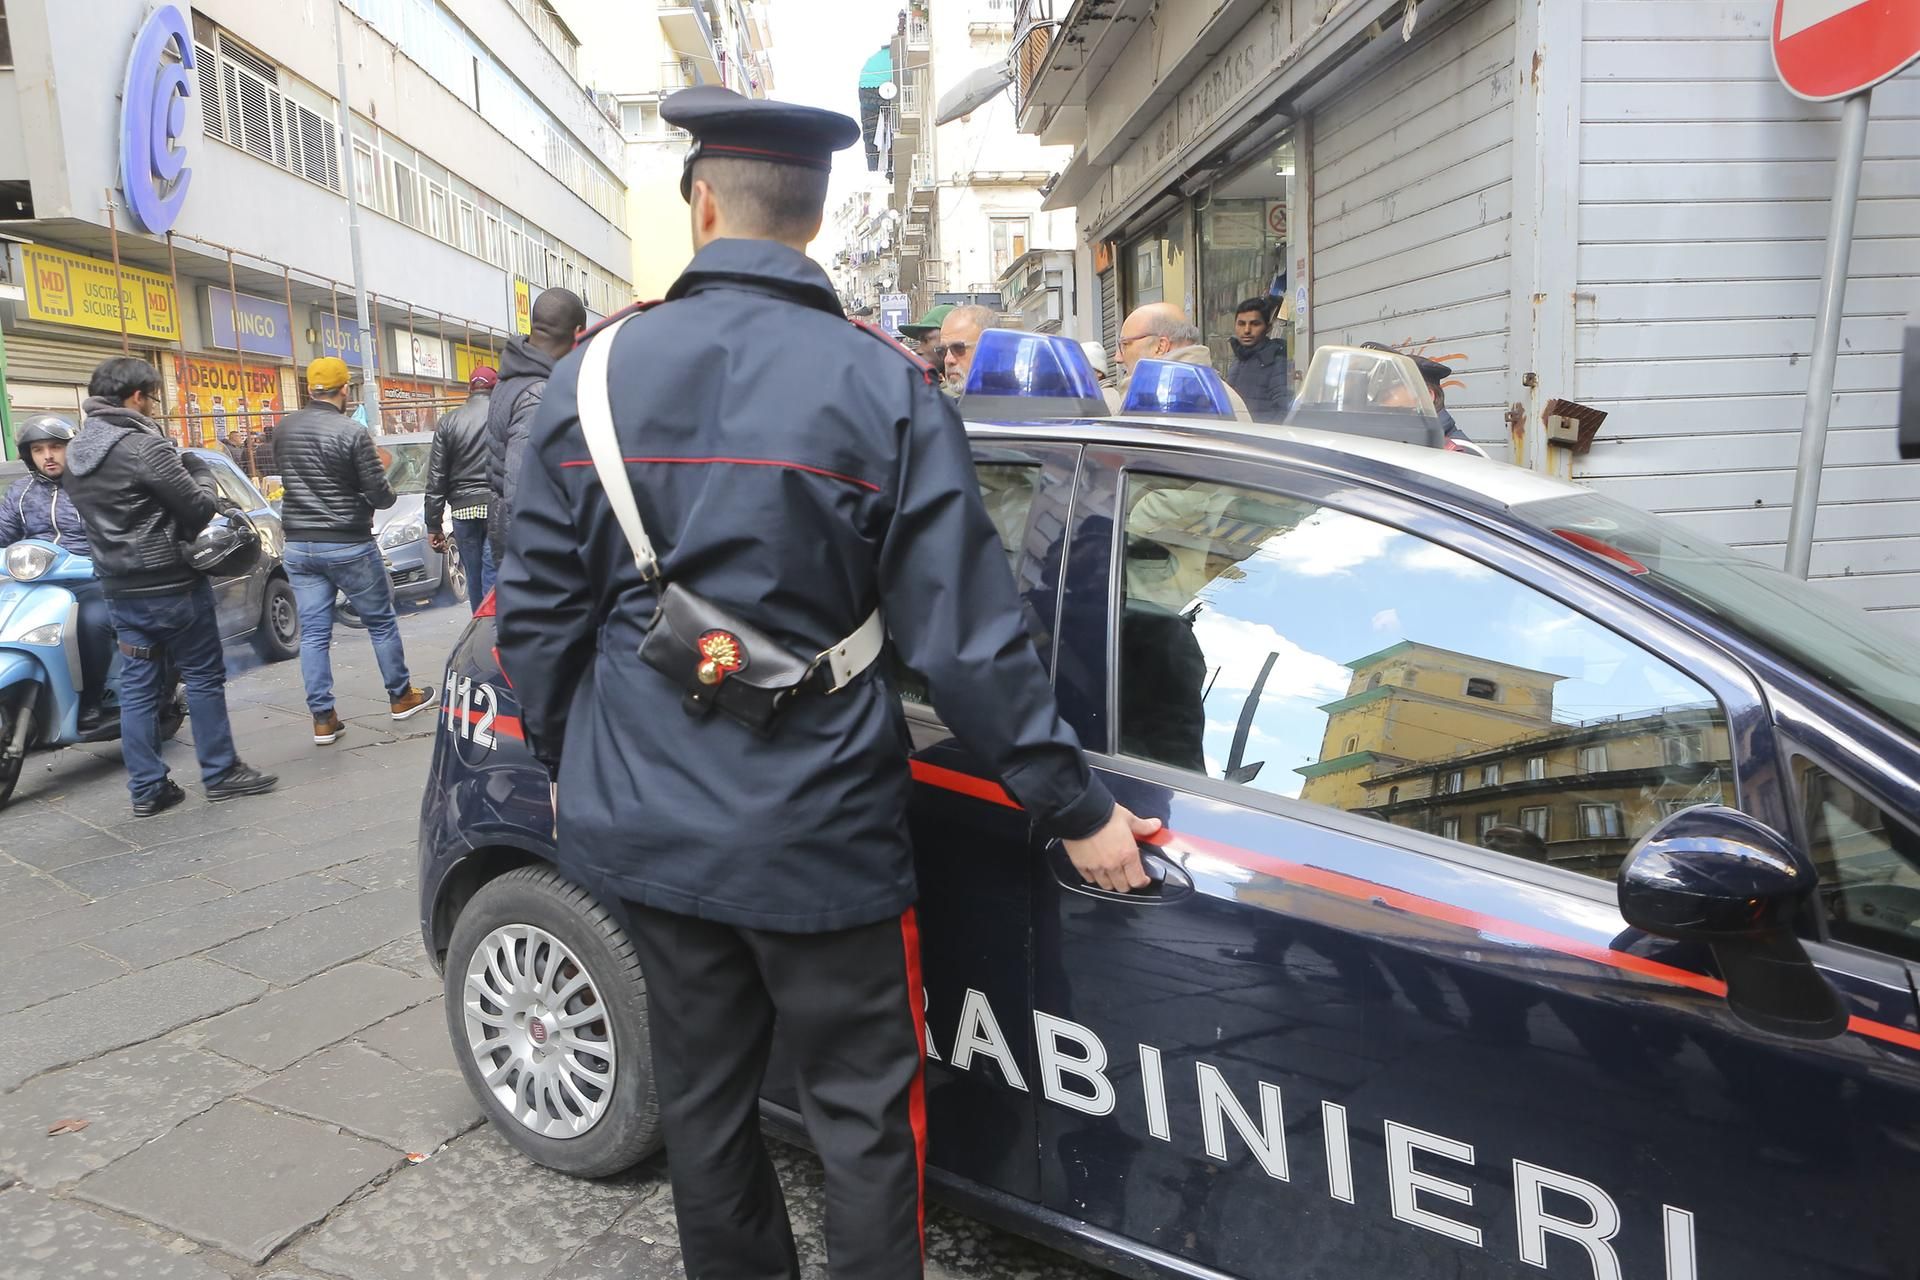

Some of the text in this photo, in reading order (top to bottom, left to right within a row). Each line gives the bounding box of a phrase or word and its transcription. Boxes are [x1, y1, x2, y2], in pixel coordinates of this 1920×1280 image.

[39, 269, 65, 293] MD
[84, 282, 118, 300] USCITA
[83, 299, 138, 321] SICUREZZA
[148, 292, 167, 313] MD
[516, 291, 529, 315] MD
[231, 309, 275, 338] BINGO
[887, 311, 902, 330] T
[176, 363, 276, 393] VDEOLOTERY
[446, 667, 498, 751] 112
[923, 986, 1703, 1280] ABINIERI
